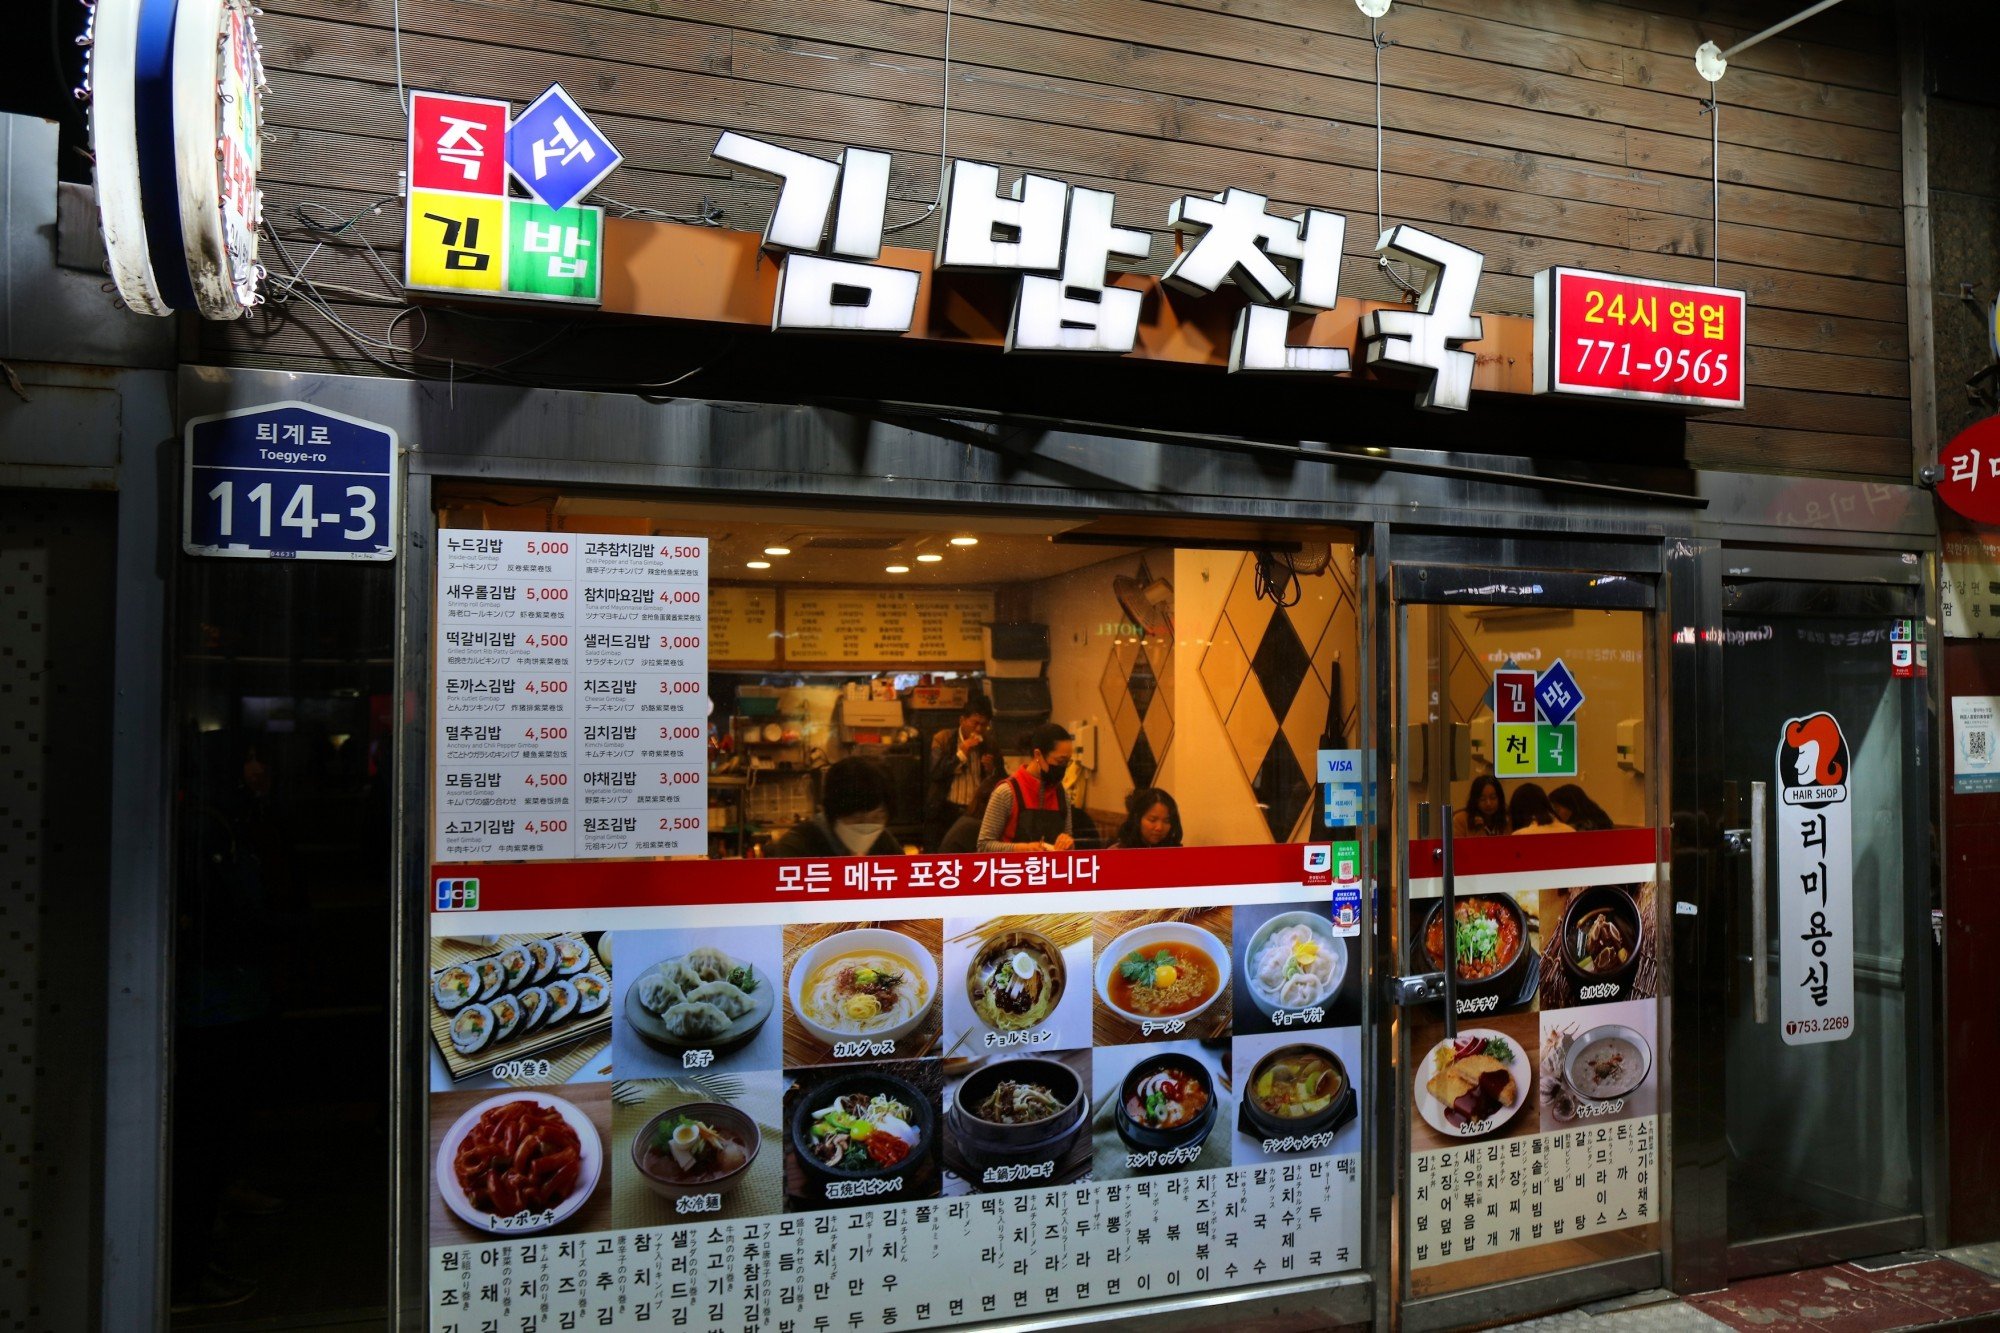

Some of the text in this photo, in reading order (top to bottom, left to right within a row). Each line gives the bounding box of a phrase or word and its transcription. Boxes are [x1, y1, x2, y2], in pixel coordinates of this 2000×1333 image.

[436, 115, 596, 181] 즉석
[423, 212, 591, 279] 김밥
[711, 128, 1485, 413] 김밥천국
[1585, 290, 1724, 340] 24시 영업
[1576, 337, 1729, 387] 771-9565
[255, 423, 331, 445] 퇴계로
[259, 448, 327, 463] Toegye-ro
[208, 481, 377, 541] 114-3
[447, 538, 569, 555] 누드김밥 5,000
[584, 542, 700, 559] 고추참치김밥 4,500
[446, 584, 569, 602] 새우롤김밥 5,000
[584, 587, 700, 605] 참치마요김밥 4,000
[446, 631, 568, 648] 떡갈비김밥 4,500
[584, 633, 700, 650] 샐러드김밥 3,000
[1892, 625, 1911, 635] JCB
[446, 678, 568, 695] 돈까스김밥 4,500
[584, 679, 700, 695] 치즈김밥 3,000
[1503, 680, 1572, 713] 김밥
[446, 725, 568, 741] 멸추김밥 4,500
[584, 725, 700, 741] 김치김밥 3,000
[1506, 732, 1564, 767] 천국
[445, 772, 568, 788] 모듬김밥 4,500
[583, 771, 700, 787] 야채김밥 3,000
[1328, 760, 1353, 772] VISA
[1792, 788, 1838, 800] HAIR SHOP
[445, 819, 568, 835] 소고기김밥 4,500
[583, 817, 700, 833] 원조김밥 2,500
[775, 855, 1101, 893] 모든 메뉴 포장 가능합니다
[444, 888, 477, 901] JCB
[1800, 813, 1833, 1007] 리미용실
[1142, 1020, 1185, 1035] ラーメン
[1272, 1008, 1325, 1025] ギョーザ汁
[833, 1040, 894, 1057] カルグッス
[985, 1029, 1052, 1045] チョルミョン
[493, 1060, 550, 1078] のり巻き
[683, 1050, 713, 1067] 餃子
[1459, 1119, 1494, 1135] とんカツ
[1509, 1141, 1521, 1243] 된장찌개
[1553, 1134, 1565, 1235] 비빔밥
[1575, 1131, 1586, 1231] 갈비탕
[1596, 1128, 1607, 1225] 오므라이스
[1308, 1161, 1323, 1266] 만두국
[1336, 1158, 1350, 1262] 떡국
[1416, 1155, 1429, 1261] 김치덮밥
[1440, 1153, 1452, 1256] 오징어덮밥
[1463, 1148, 1476, 1252] 새우볶음밥
[1486, 1145, 1499, 1247] 김치찌개
[489, 1209, 555, 1229] トッポッキ
[1195, 1174, 1211, 1283] 치즈떡볶이
[1224, 1171, 1240, 1279] 잔치국수
[1253, 1168, 1267, 1275] 칼국수
[1281, 1164, 1295, 1270] 김치수제비
[949, 1202, 964, 1317] 라면
[981, 1198, 997, 1313] 떡라면
[1013, 1194, 1029, 1308] 김치라면
[1044, 1191, 1060, 1304] 치즈라면
[1075, 1188, 1091, 1300] 만두라면
[848, 1213, 865, 1329] 고기만두
[881, 1208, 898, 1326] 김치우동
